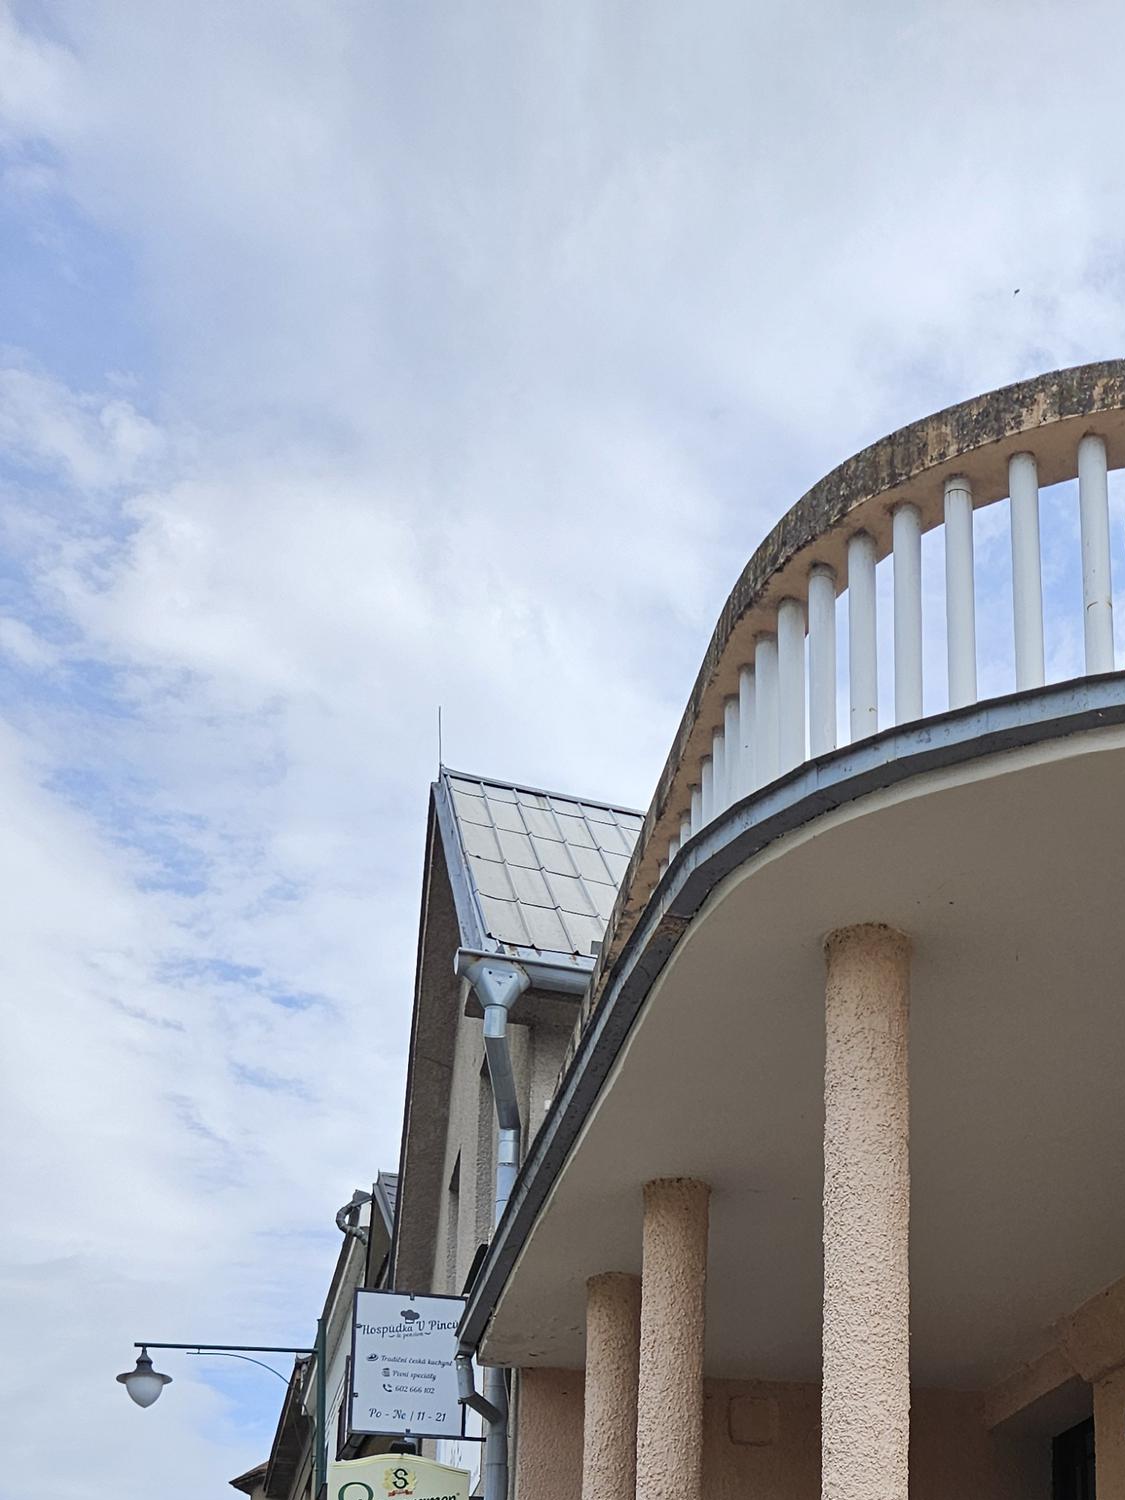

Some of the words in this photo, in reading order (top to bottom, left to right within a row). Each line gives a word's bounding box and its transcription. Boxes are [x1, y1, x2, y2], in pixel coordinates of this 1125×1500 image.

[416, 1321, 426, 1332] V
[369, 1407, 383, 1419] Po
[417, 1411, 426, 1422] 11
[435, 1411, 447, 1422] 21
